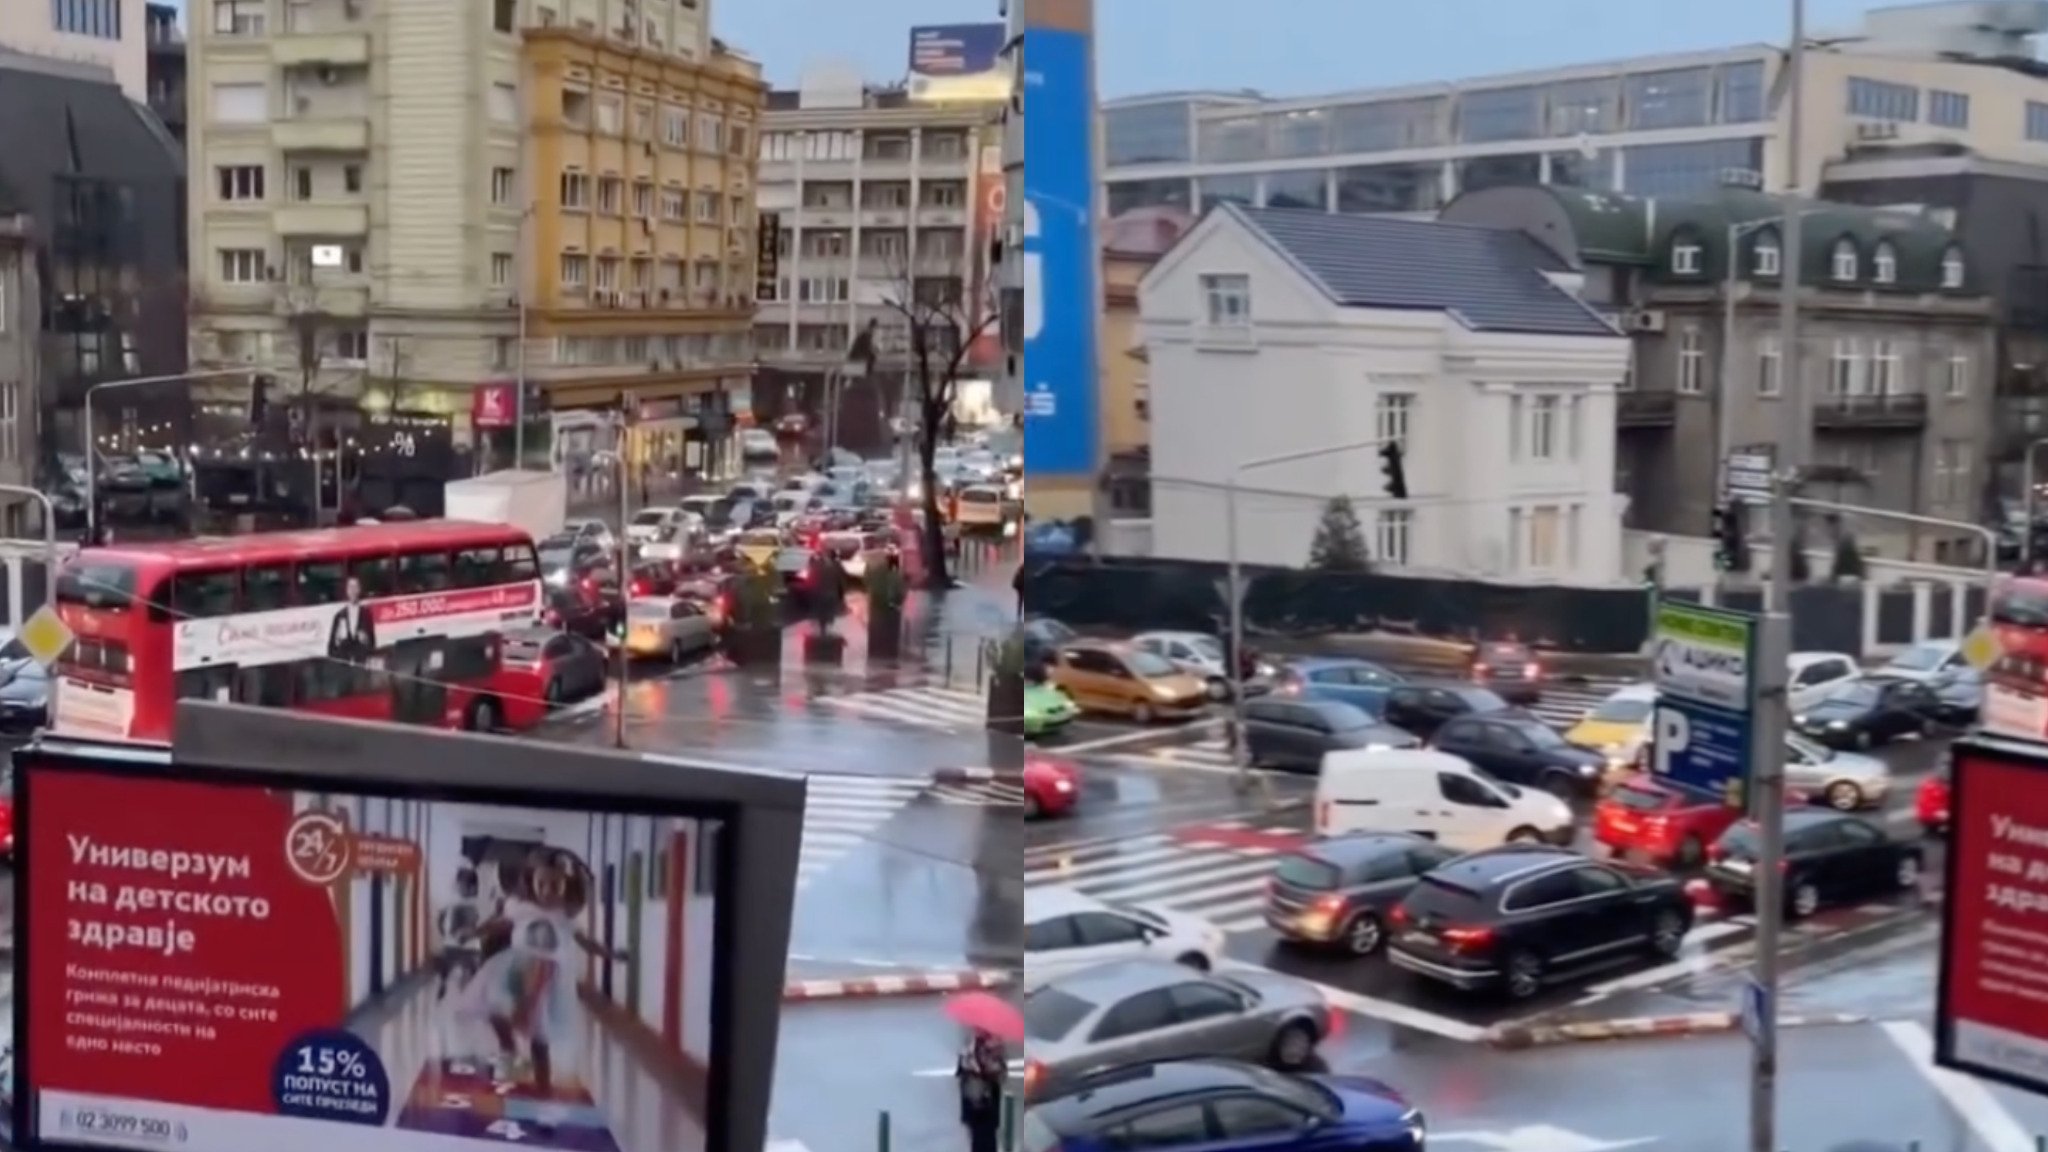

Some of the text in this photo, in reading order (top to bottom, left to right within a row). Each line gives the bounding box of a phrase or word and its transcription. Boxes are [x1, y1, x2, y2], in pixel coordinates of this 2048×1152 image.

[1655, 706, 1690, 774] P
[66, 833, 250, 884] Универзум
[67, 880, 270, 919] на детското
[67, 919, 195, 956] здравје
[213, 1003, 235, 1018] со
[238, 1008, 279, 1023] сите
[195, 1026, 217, 1041] на
[297, 1045, 367, 1078] 15%
[284, 1073, 377, 1098] ПОПУСТ НА
